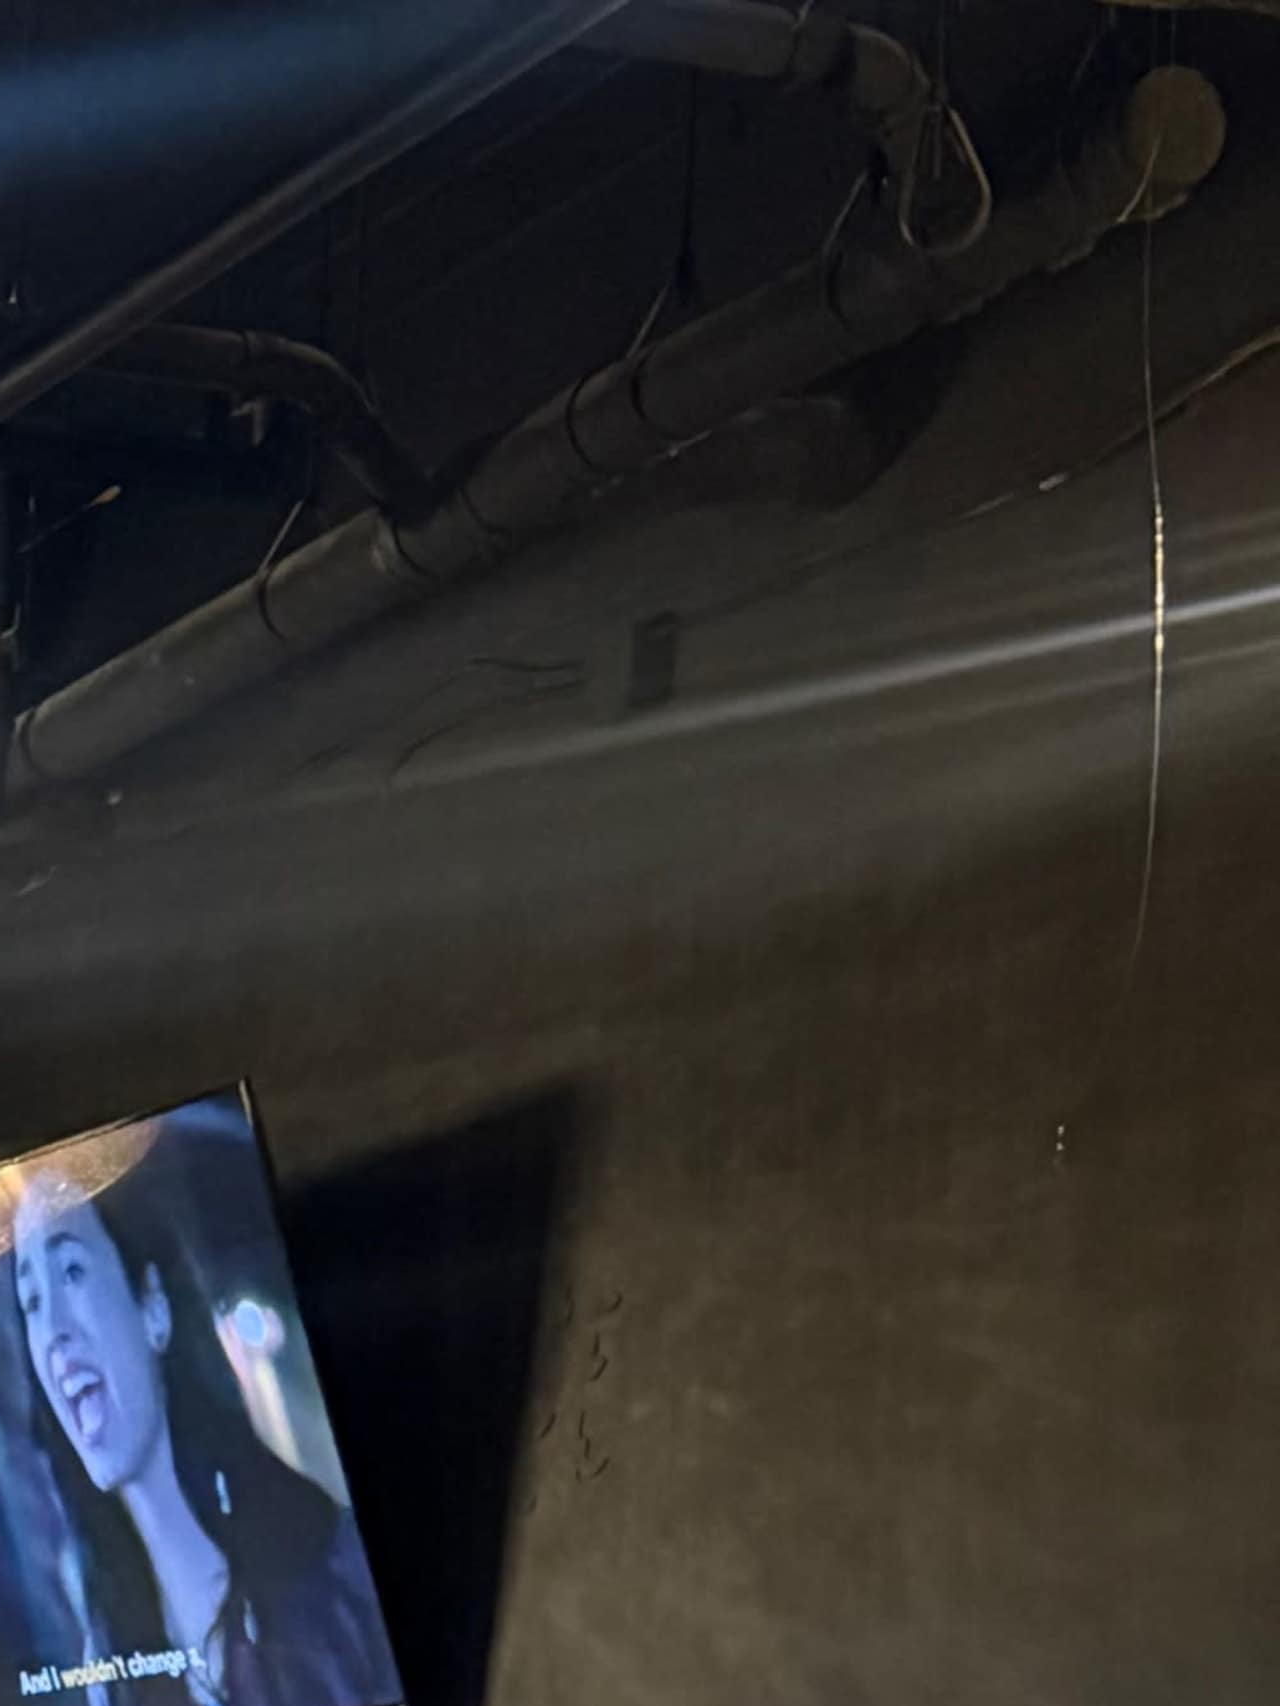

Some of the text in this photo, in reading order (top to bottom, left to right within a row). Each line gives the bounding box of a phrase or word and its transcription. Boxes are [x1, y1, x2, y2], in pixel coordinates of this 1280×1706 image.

[19, 1666, 52, 1696] And
[50, 1665, 61, 1691] I
[61, 1655, 128, 1688] wouldn't
[127, 1650, 187, 1678] change
